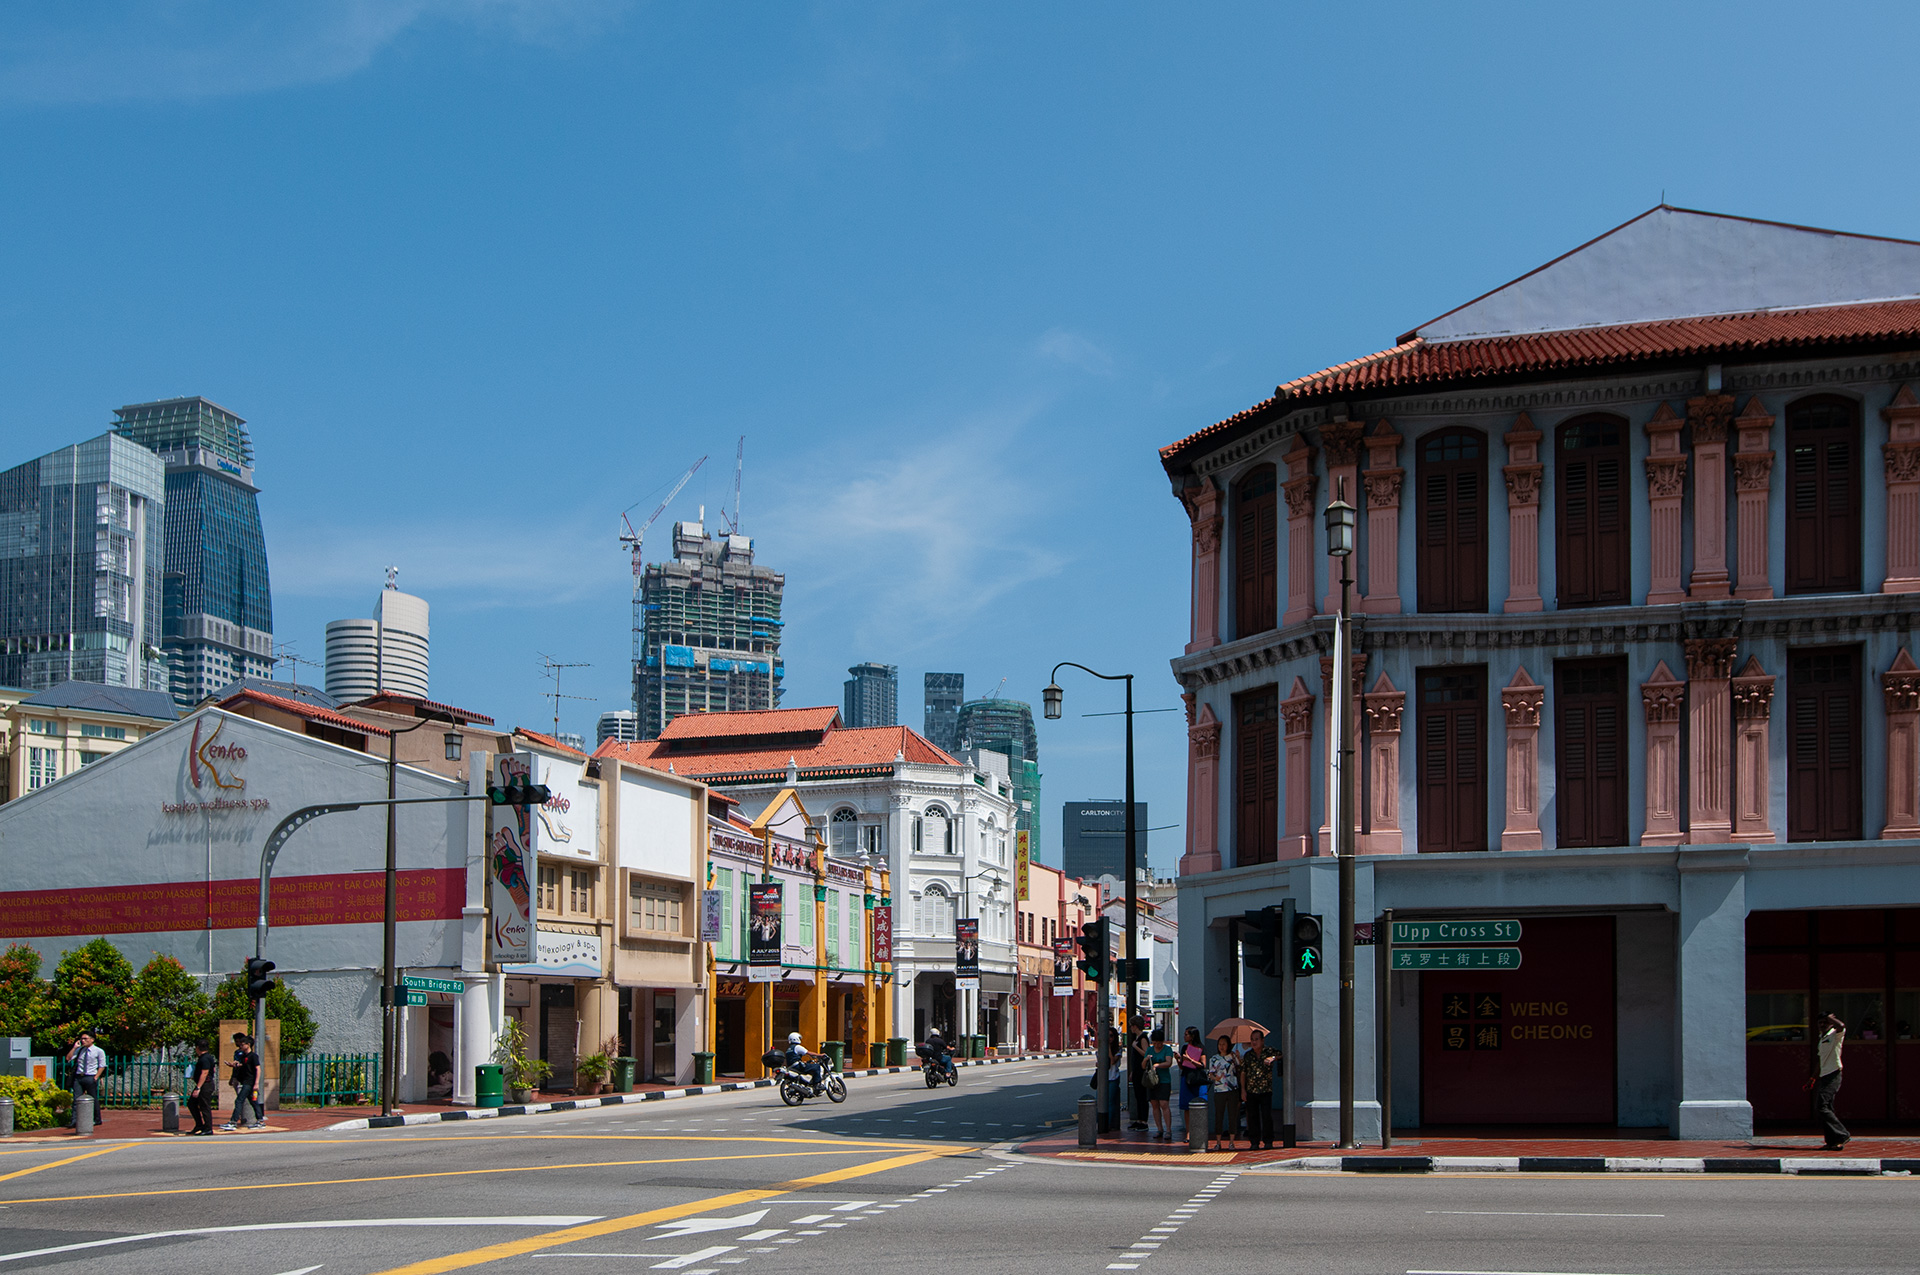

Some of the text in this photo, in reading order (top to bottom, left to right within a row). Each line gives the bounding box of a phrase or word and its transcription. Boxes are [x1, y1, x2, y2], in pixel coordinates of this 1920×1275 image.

[162, 797, 268, 812] kenko wellness spa
[0, 897, 30, 908] OULDER
[32, 895, 69, 906] MASSAGE
[79, 891, 141, 903] AROMATHERAPY
[142, 890, 165, 900] BODY
[166, 888, 206, 899] MASSAGE
[215, 884, 270, 896] ACUPRESSU
[273, 882, 296, 894] HEAD
[298, 880, 334, 892] THERAPY
[344, 879, 360, 890] EAR
[420, 876, 437, 886] SPA
[34, 925, 71, 936] MASSAGE
[81, 921, 142, 933] AROMATHERAPY
[144, 921, 166, 931] BODY
[167, 919, 207, 929] MASSAGE
[273, 914, 297, 925] HEAD
[299, 912, 335, 923] THERAPY
[344, 911, 361, 922] EAR
[420, 908, 437, 918] SPA
[1398, 922, 1512, 941] Upp Cross St
[537, 939, 596, 954] eflexology & spa
[1400, 952, 1511, 966] 克罗士街上段
[404, 977, 462, 991] South Bridge Rd
[1510, 1001, 1569, 1017] WENG
[1445, 995, 1469, 1049] 永昌
[1511, 1024, 1593, 1039] CHEONG
